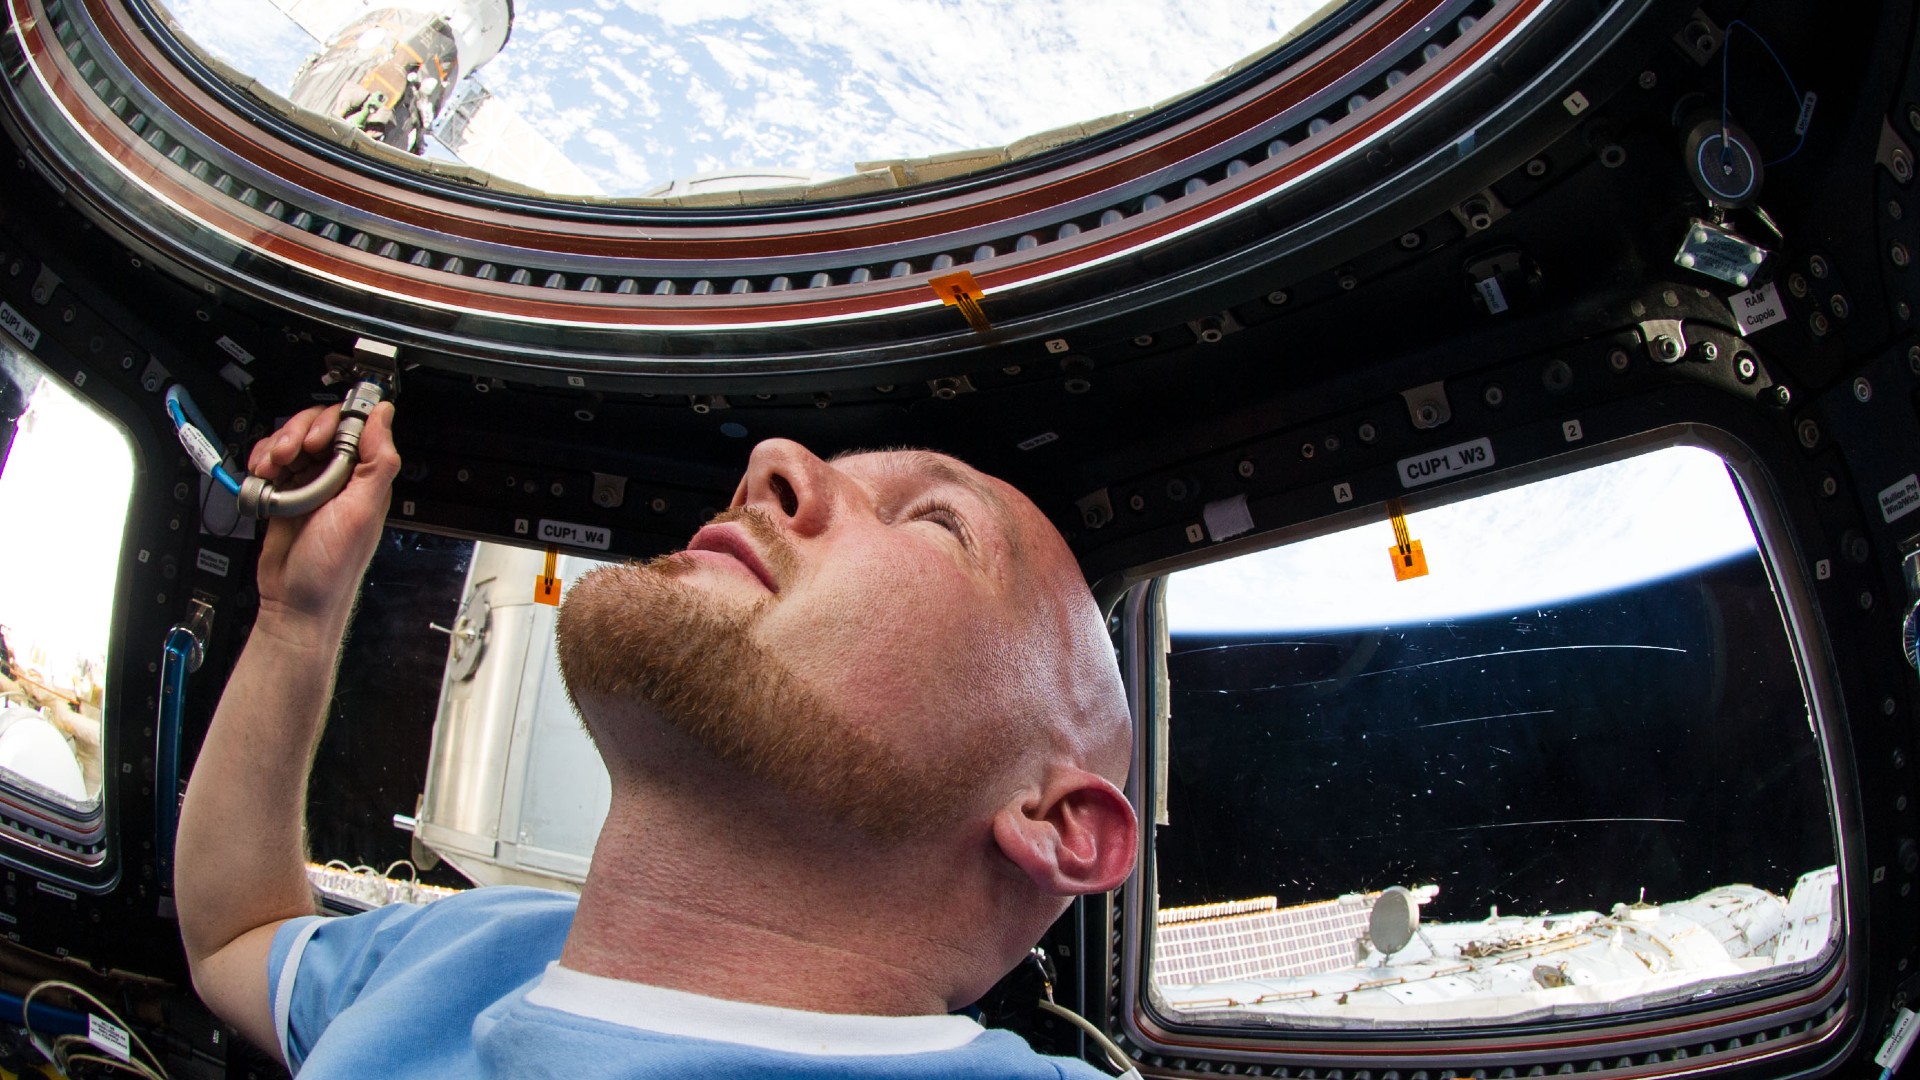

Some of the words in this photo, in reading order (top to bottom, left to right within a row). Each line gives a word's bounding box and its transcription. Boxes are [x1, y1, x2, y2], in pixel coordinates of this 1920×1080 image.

[1744, 292, 1766, 308] RAM
[1, 308, 36, 344] CUP1_W5
[1746, 308, 1777, 326] Cupola
[1568, 425, 1577, 437] 2
[1406, 446, 1486, 480] CUP1_W3
[1340, 487, 1349, 499] A
[1881, 489, 1906, 507] Mullion
[543, 524, 604, 545] CUP1_W4
